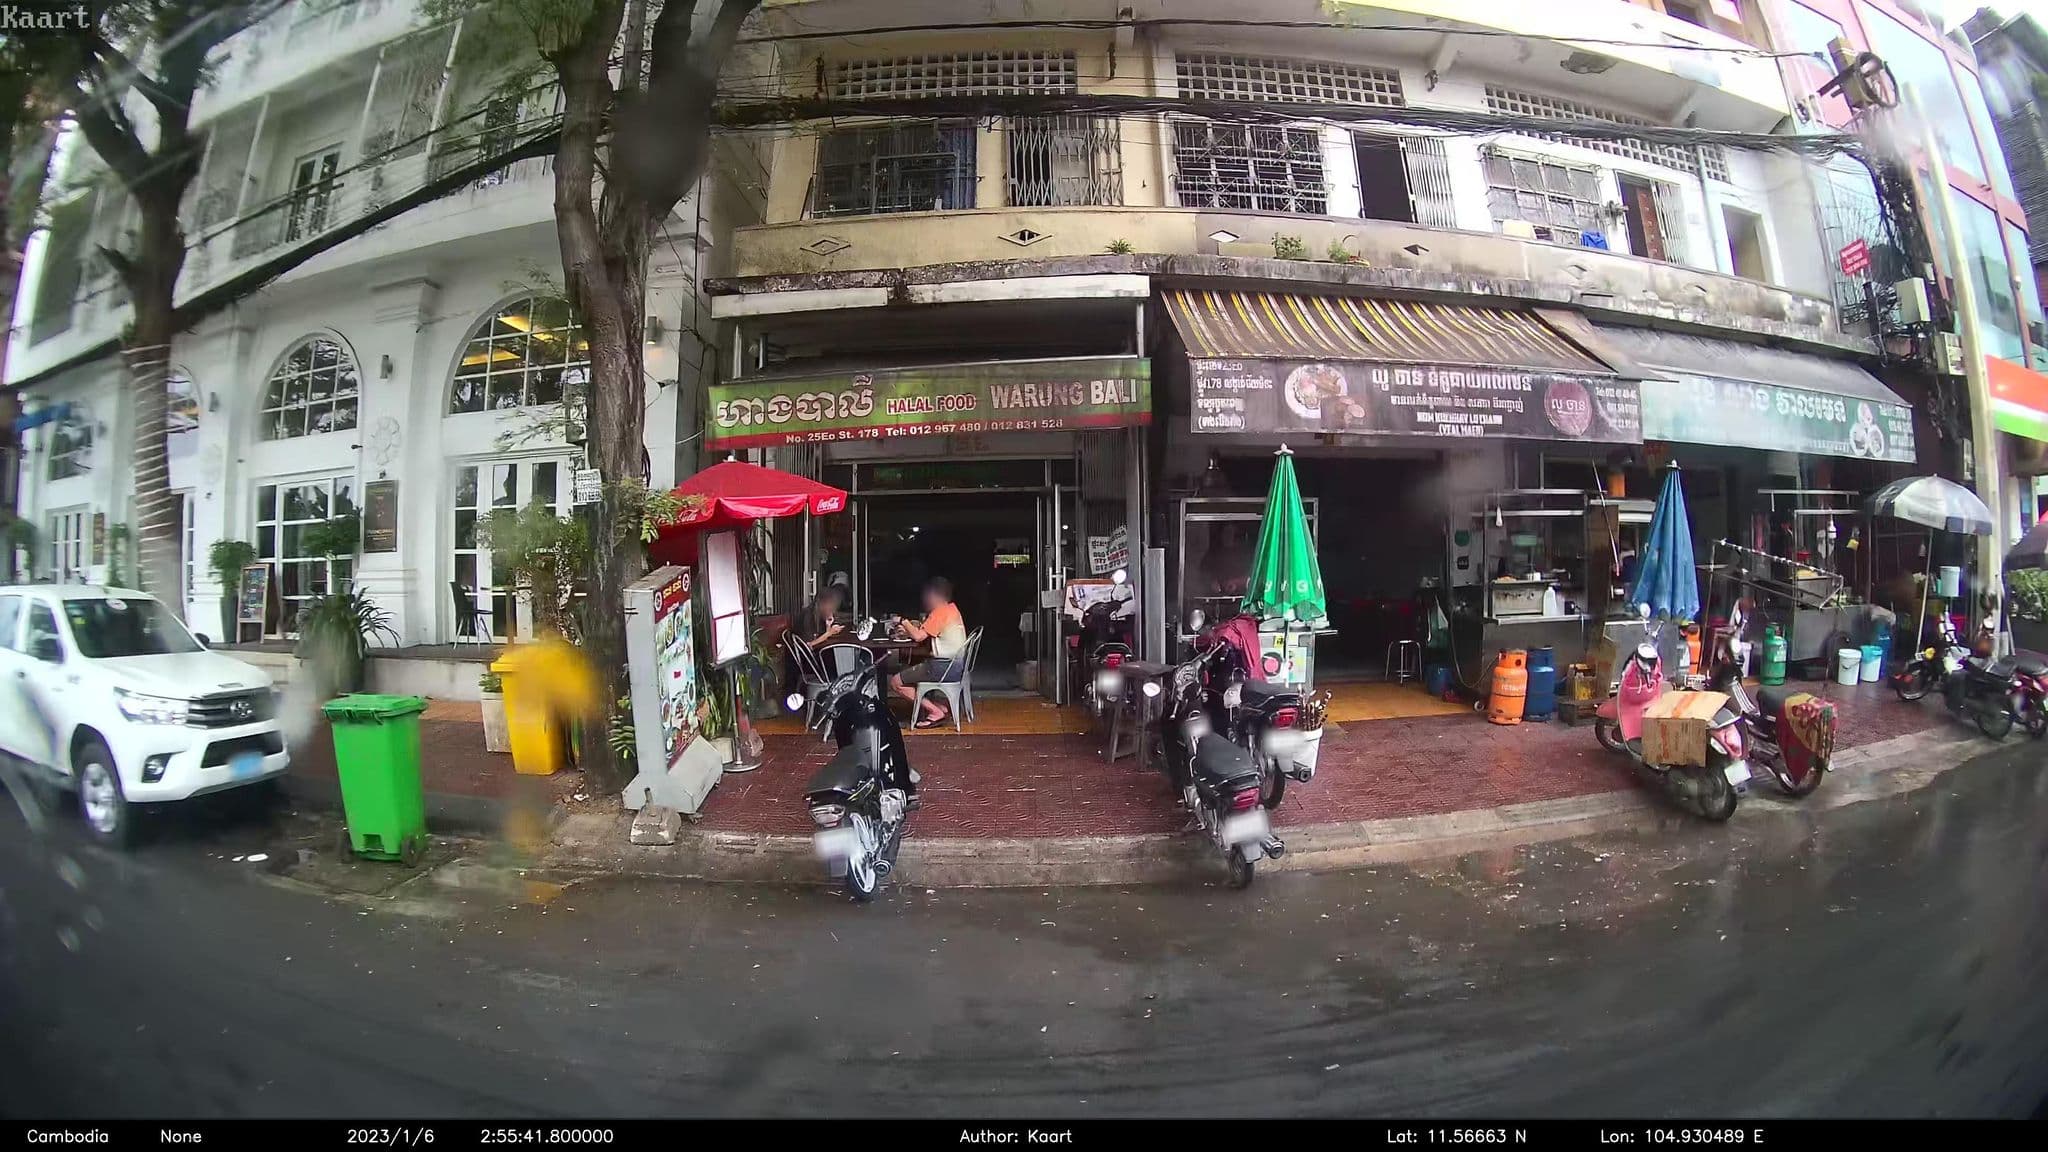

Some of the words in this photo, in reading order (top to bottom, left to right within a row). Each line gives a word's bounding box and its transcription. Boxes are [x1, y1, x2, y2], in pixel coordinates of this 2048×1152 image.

[887, 397, 933, 415] HALAL
[936, 393, 976, 412] FOOD
[991, 381, 1083, 409] WARUNG
[1090, 378, 1137, 404] BALI
[786, 434, 805, 443] No.
[839, 430, 854, 439] St.
[858, 428, 879, 438] 178
[885, 427, 907, 437] Tel:
[909, 425, 932, 435] 012
